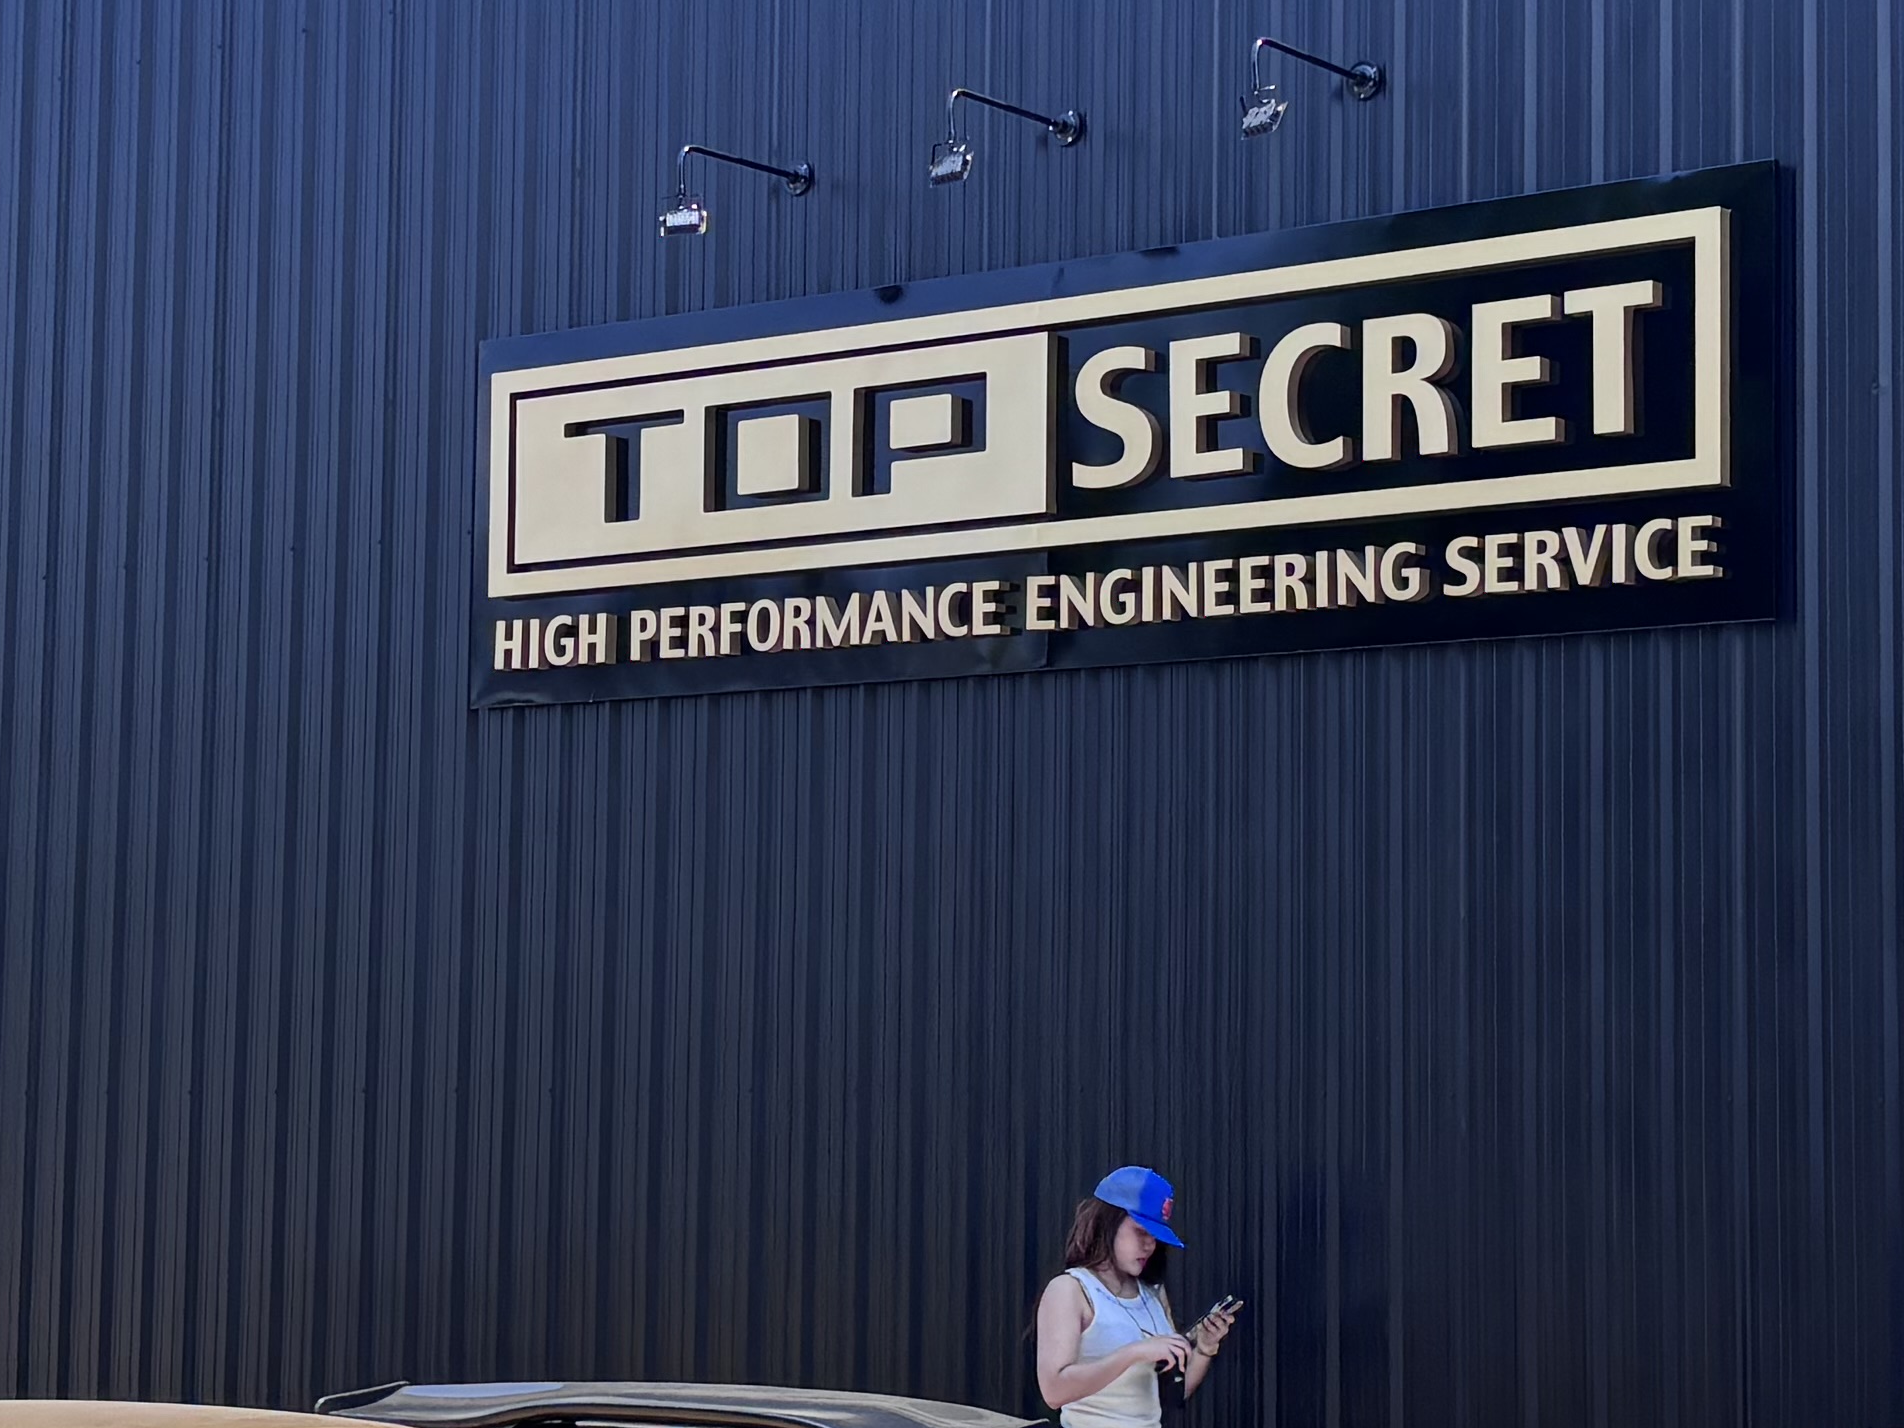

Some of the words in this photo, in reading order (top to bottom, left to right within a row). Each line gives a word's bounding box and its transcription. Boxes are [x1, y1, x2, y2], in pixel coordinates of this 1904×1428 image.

[563, 371, 988, 525] TOP
[1072, 278, 1663, 491] SECRET
[492, 613, 609, 671] HIGH
[628, 580, 1002, 663] PERFORMANCE
[1024, 541, 1416, 631] ENGINEERING
[1441, 516, 1719, 596] SERVICE
